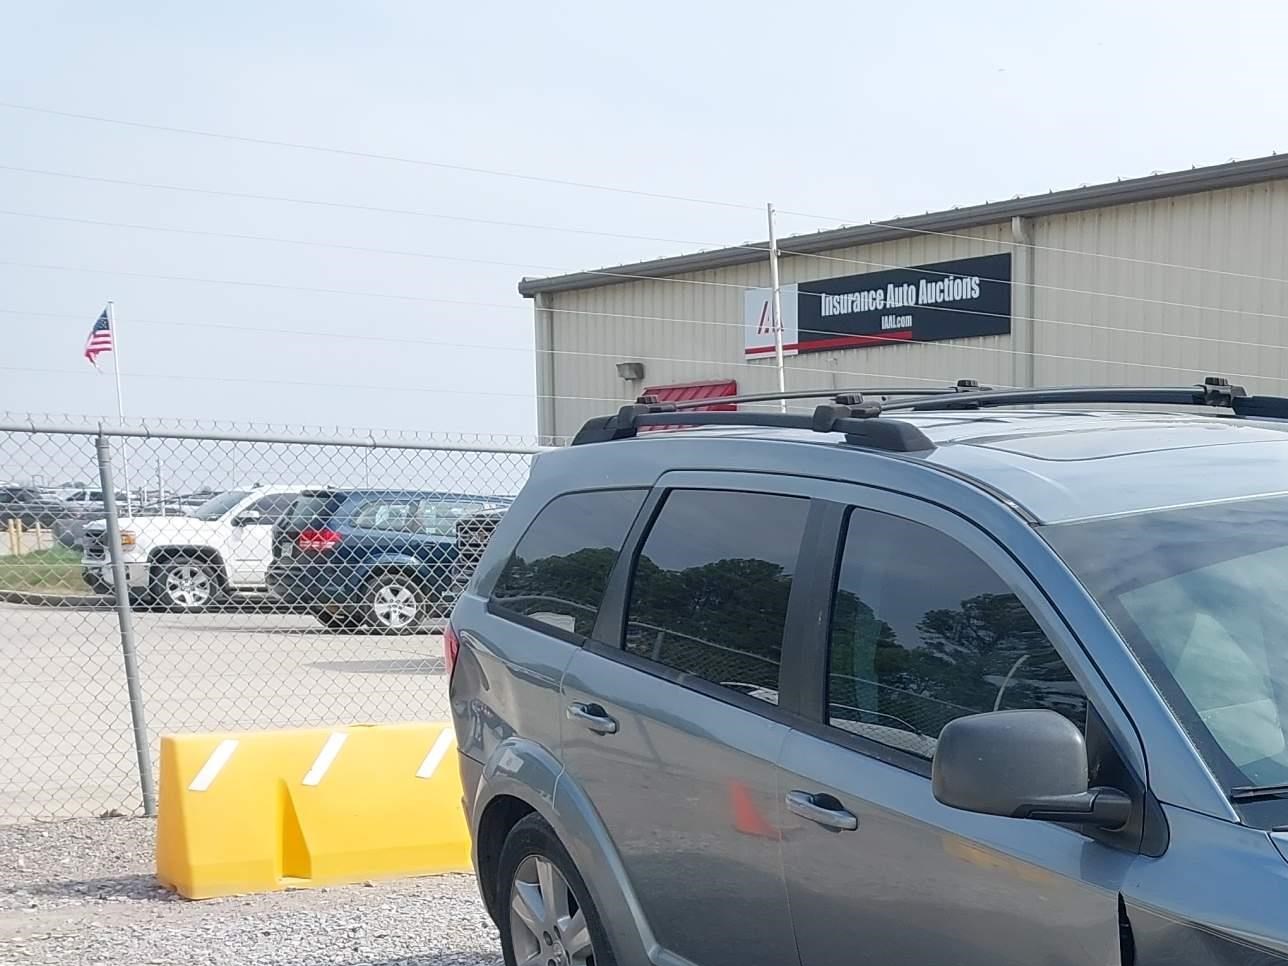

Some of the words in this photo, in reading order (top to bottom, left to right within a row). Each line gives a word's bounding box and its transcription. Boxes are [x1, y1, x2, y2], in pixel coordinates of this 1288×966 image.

[821, 288, 884, 317] Insurance
[886, 283, 916, 308] Auto
[918, 275, 980, 305] Auctions
